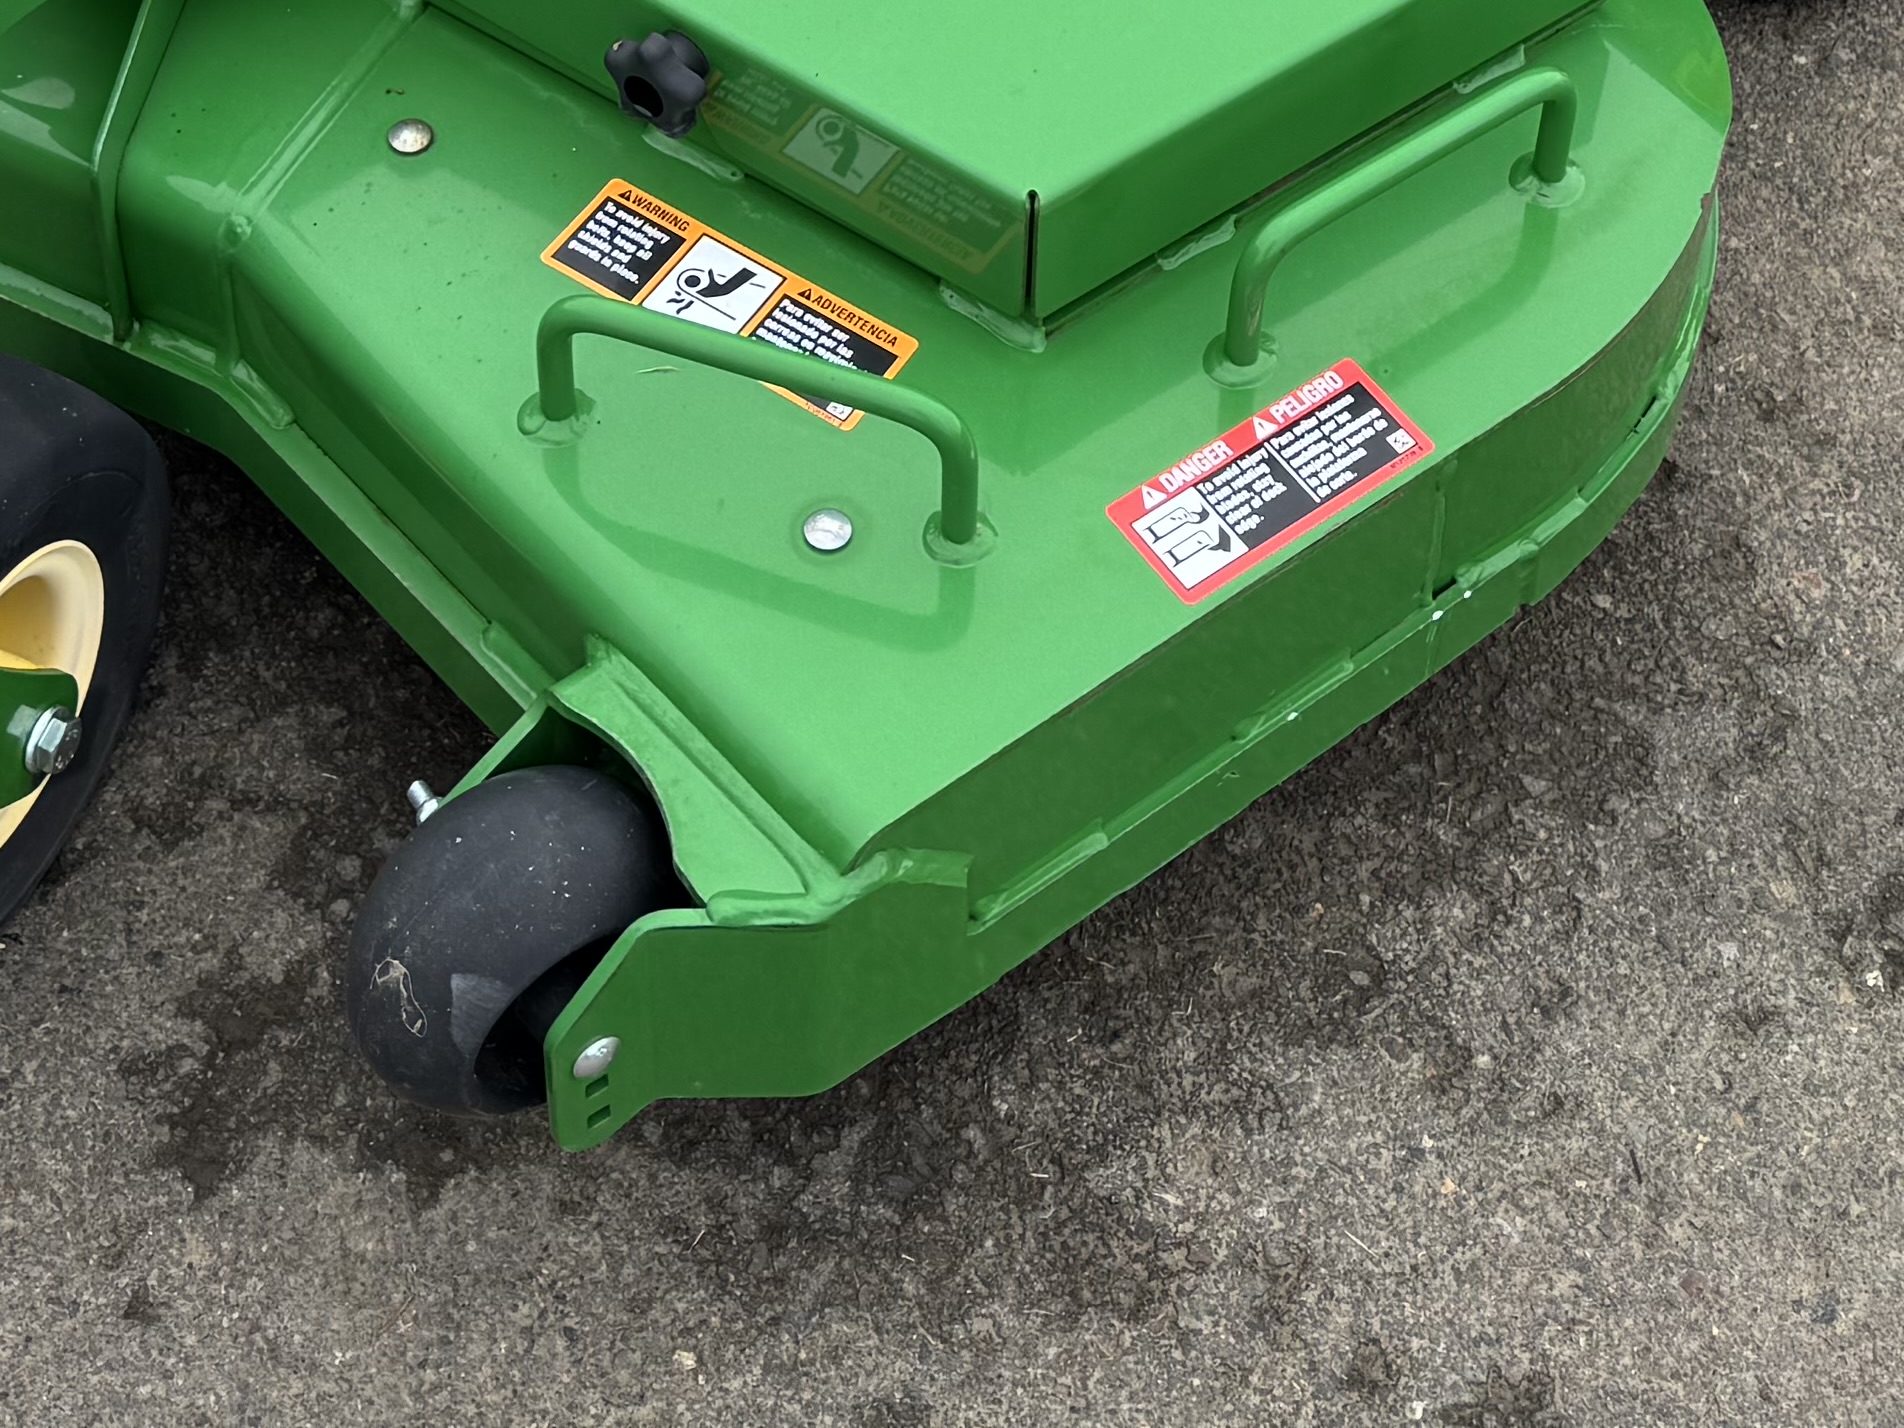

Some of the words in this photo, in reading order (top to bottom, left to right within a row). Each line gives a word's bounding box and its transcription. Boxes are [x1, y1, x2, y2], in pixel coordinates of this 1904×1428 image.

[631, 195, 689, 232] WARNING
[811, 294, 898, 346] ADVERTENCIA
[1159, 440, 1233, 492] DANGER
[1269, 371, 1343, 423] PELIGRO
